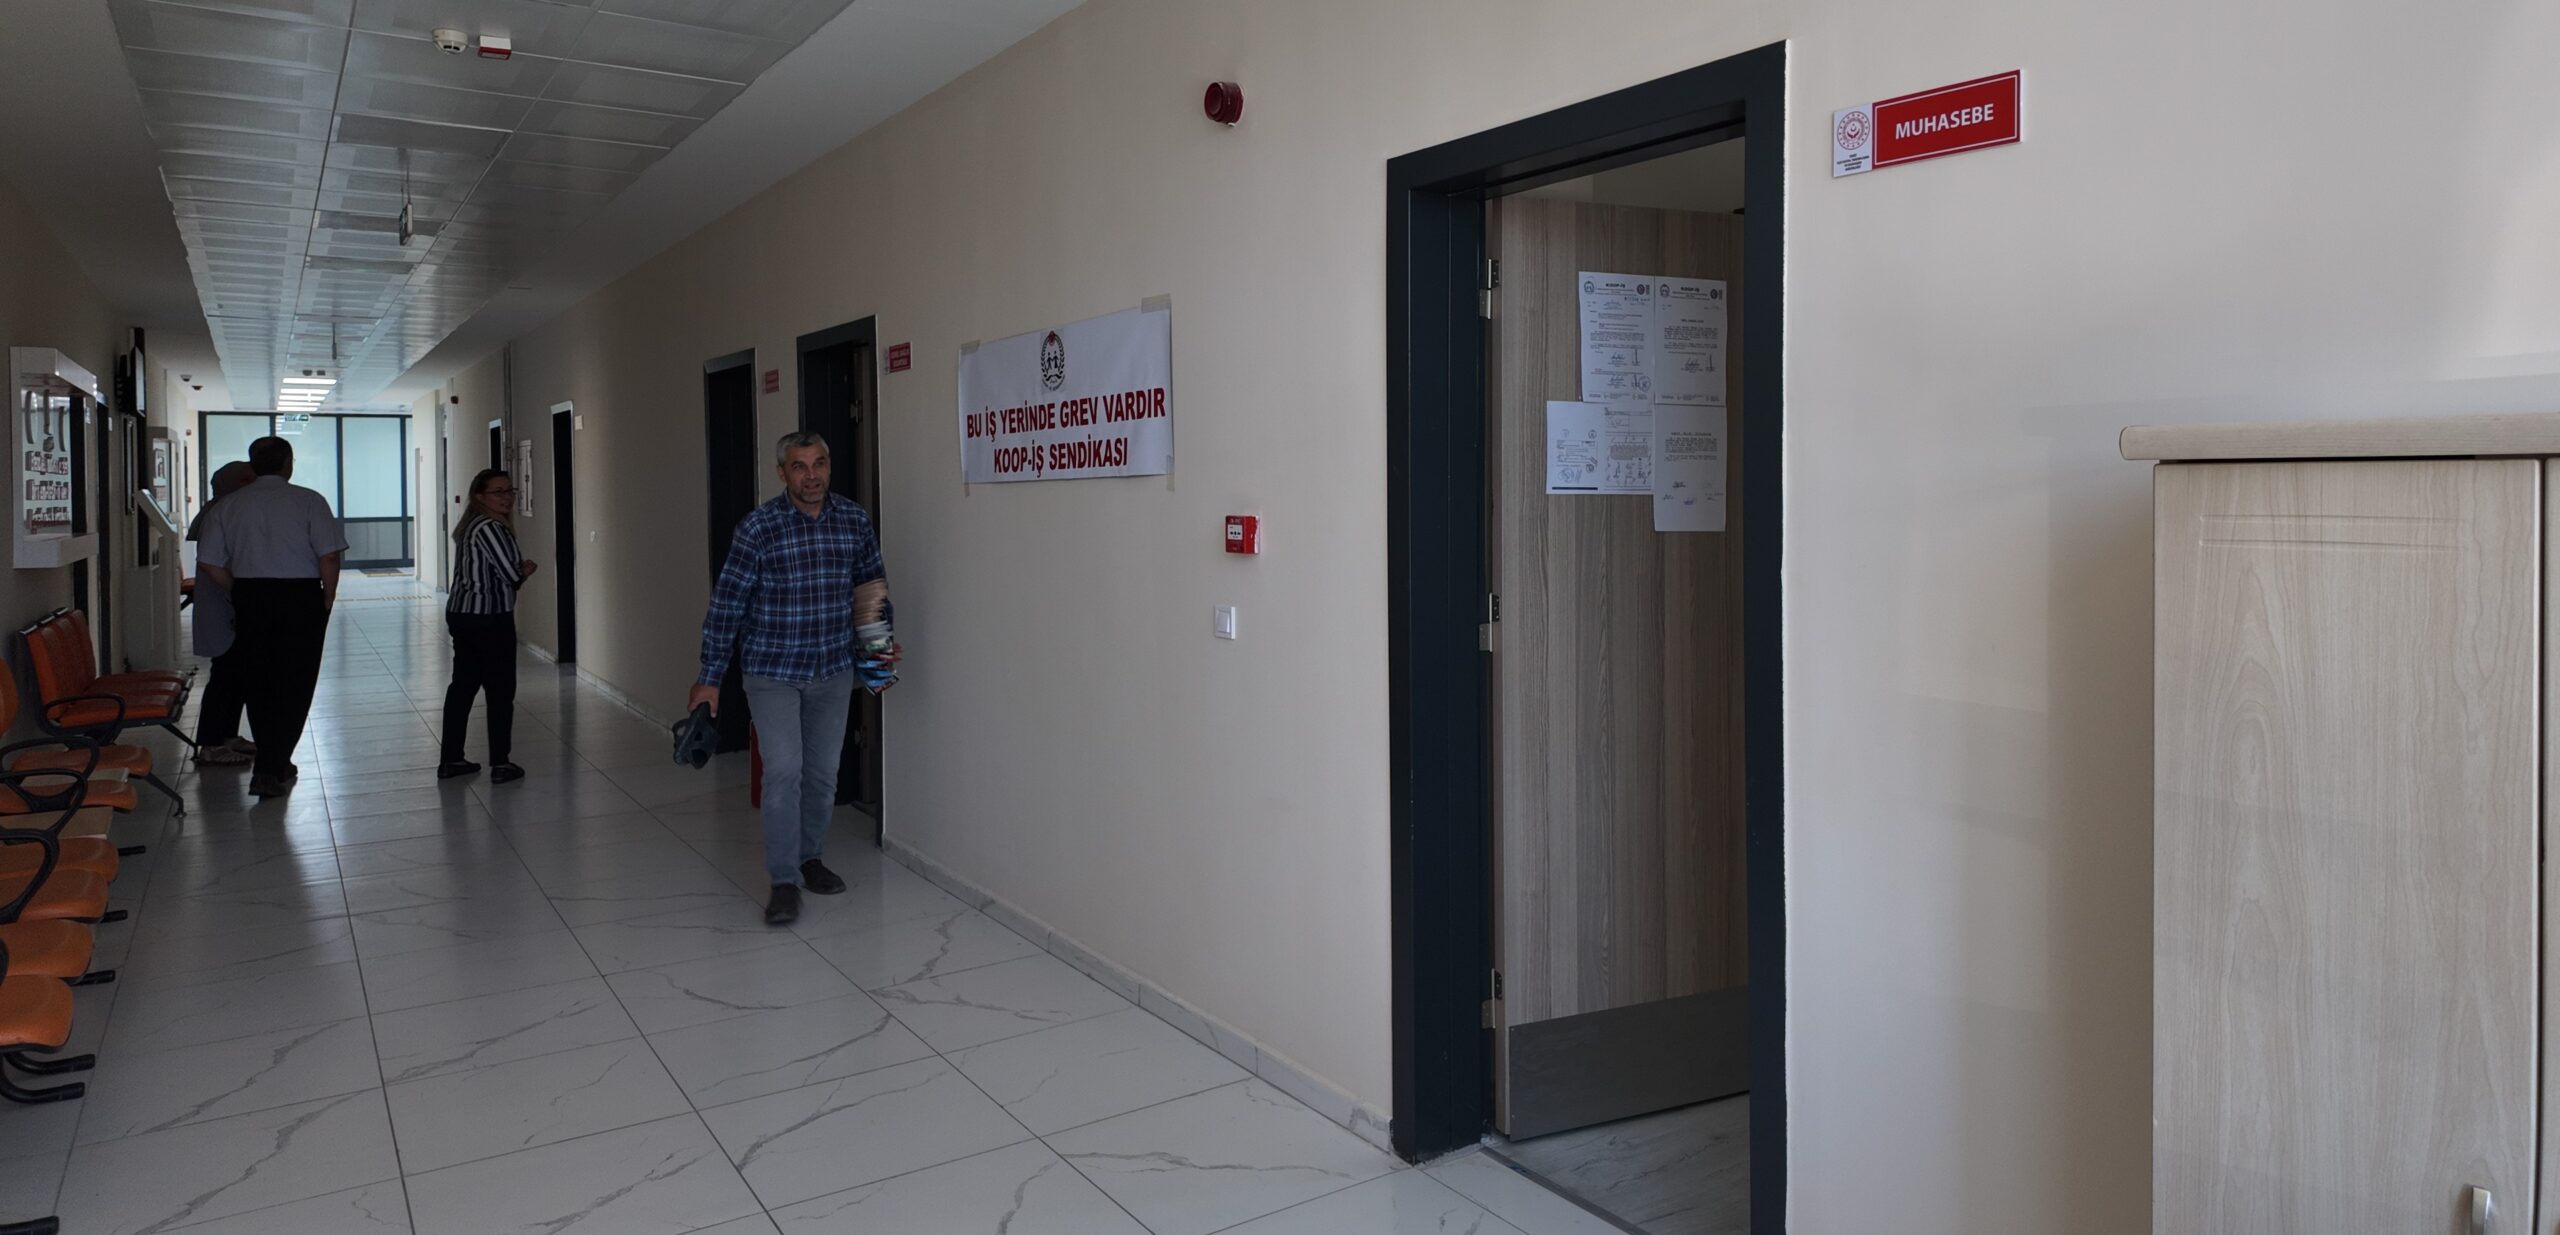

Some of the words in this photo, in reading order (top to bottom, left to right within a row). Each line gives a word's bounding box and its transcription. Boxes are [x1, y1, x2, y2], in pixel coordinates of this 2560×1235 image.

[1895, 103, 1994, 140] MUHASEBE
[966, 412, 983, 439] BU
[985, 406, 997, 442] İŞ
[1001, 400, 1056, 434] YERİNDE
[1059, 395, 1099, 429] GREV
[1102, 387, 1166, 423] VARDIR
[993, 440, 1044, 478] KOOP-İŞ
[1049, 434, 1129, 471] SENDİKASI
